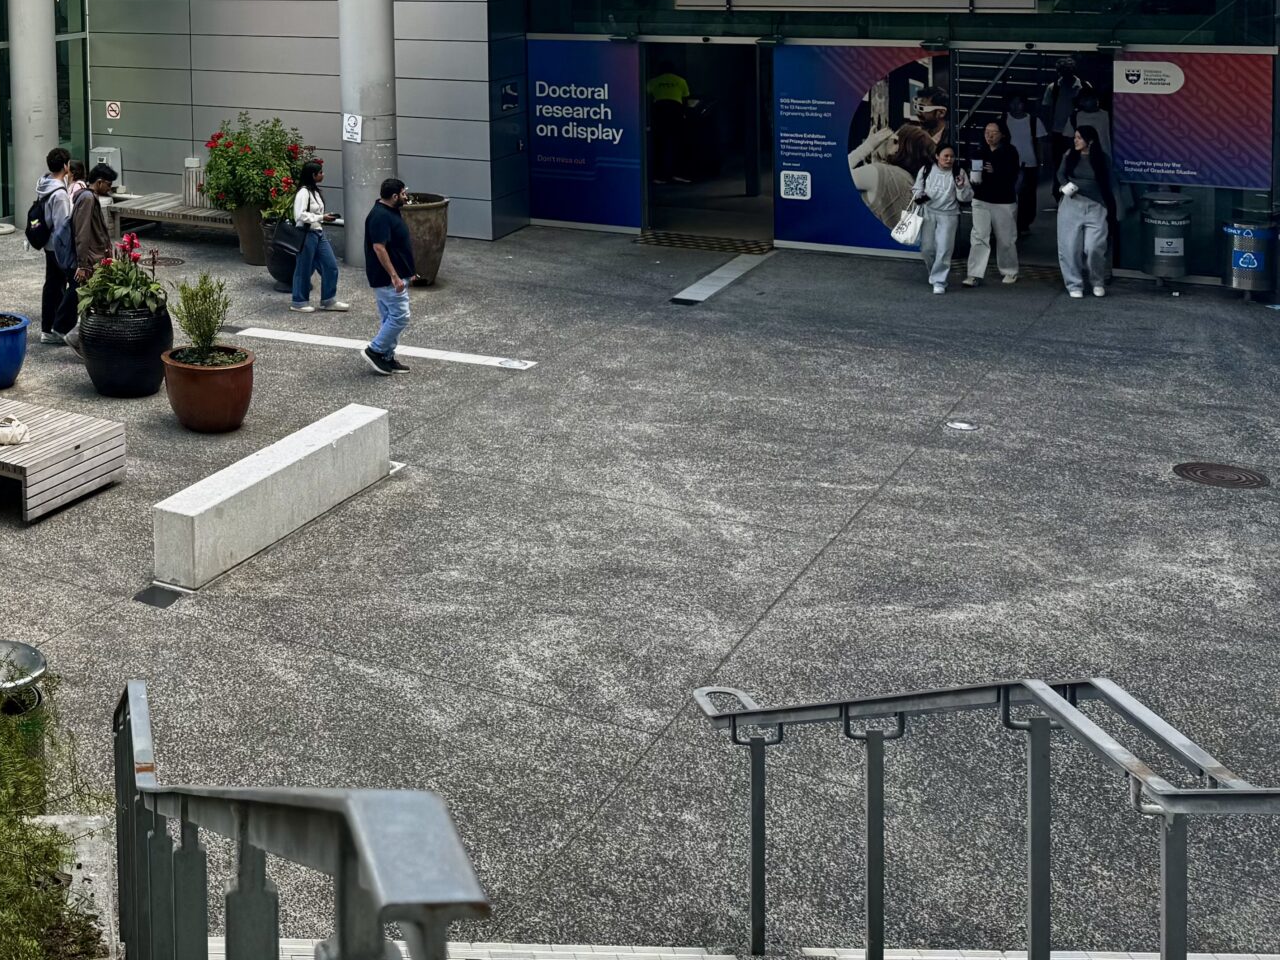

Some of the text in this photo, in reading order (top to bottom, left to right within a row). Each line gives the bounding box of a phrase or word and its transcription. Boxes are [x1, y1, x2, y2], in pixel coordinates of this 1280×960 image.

[536, 80, 608, 100] Doctoral
[536, 103, 612, 120] research
[536, 121, 624, 145] on display
[1144, 217, 1170, 226] GENERAL
